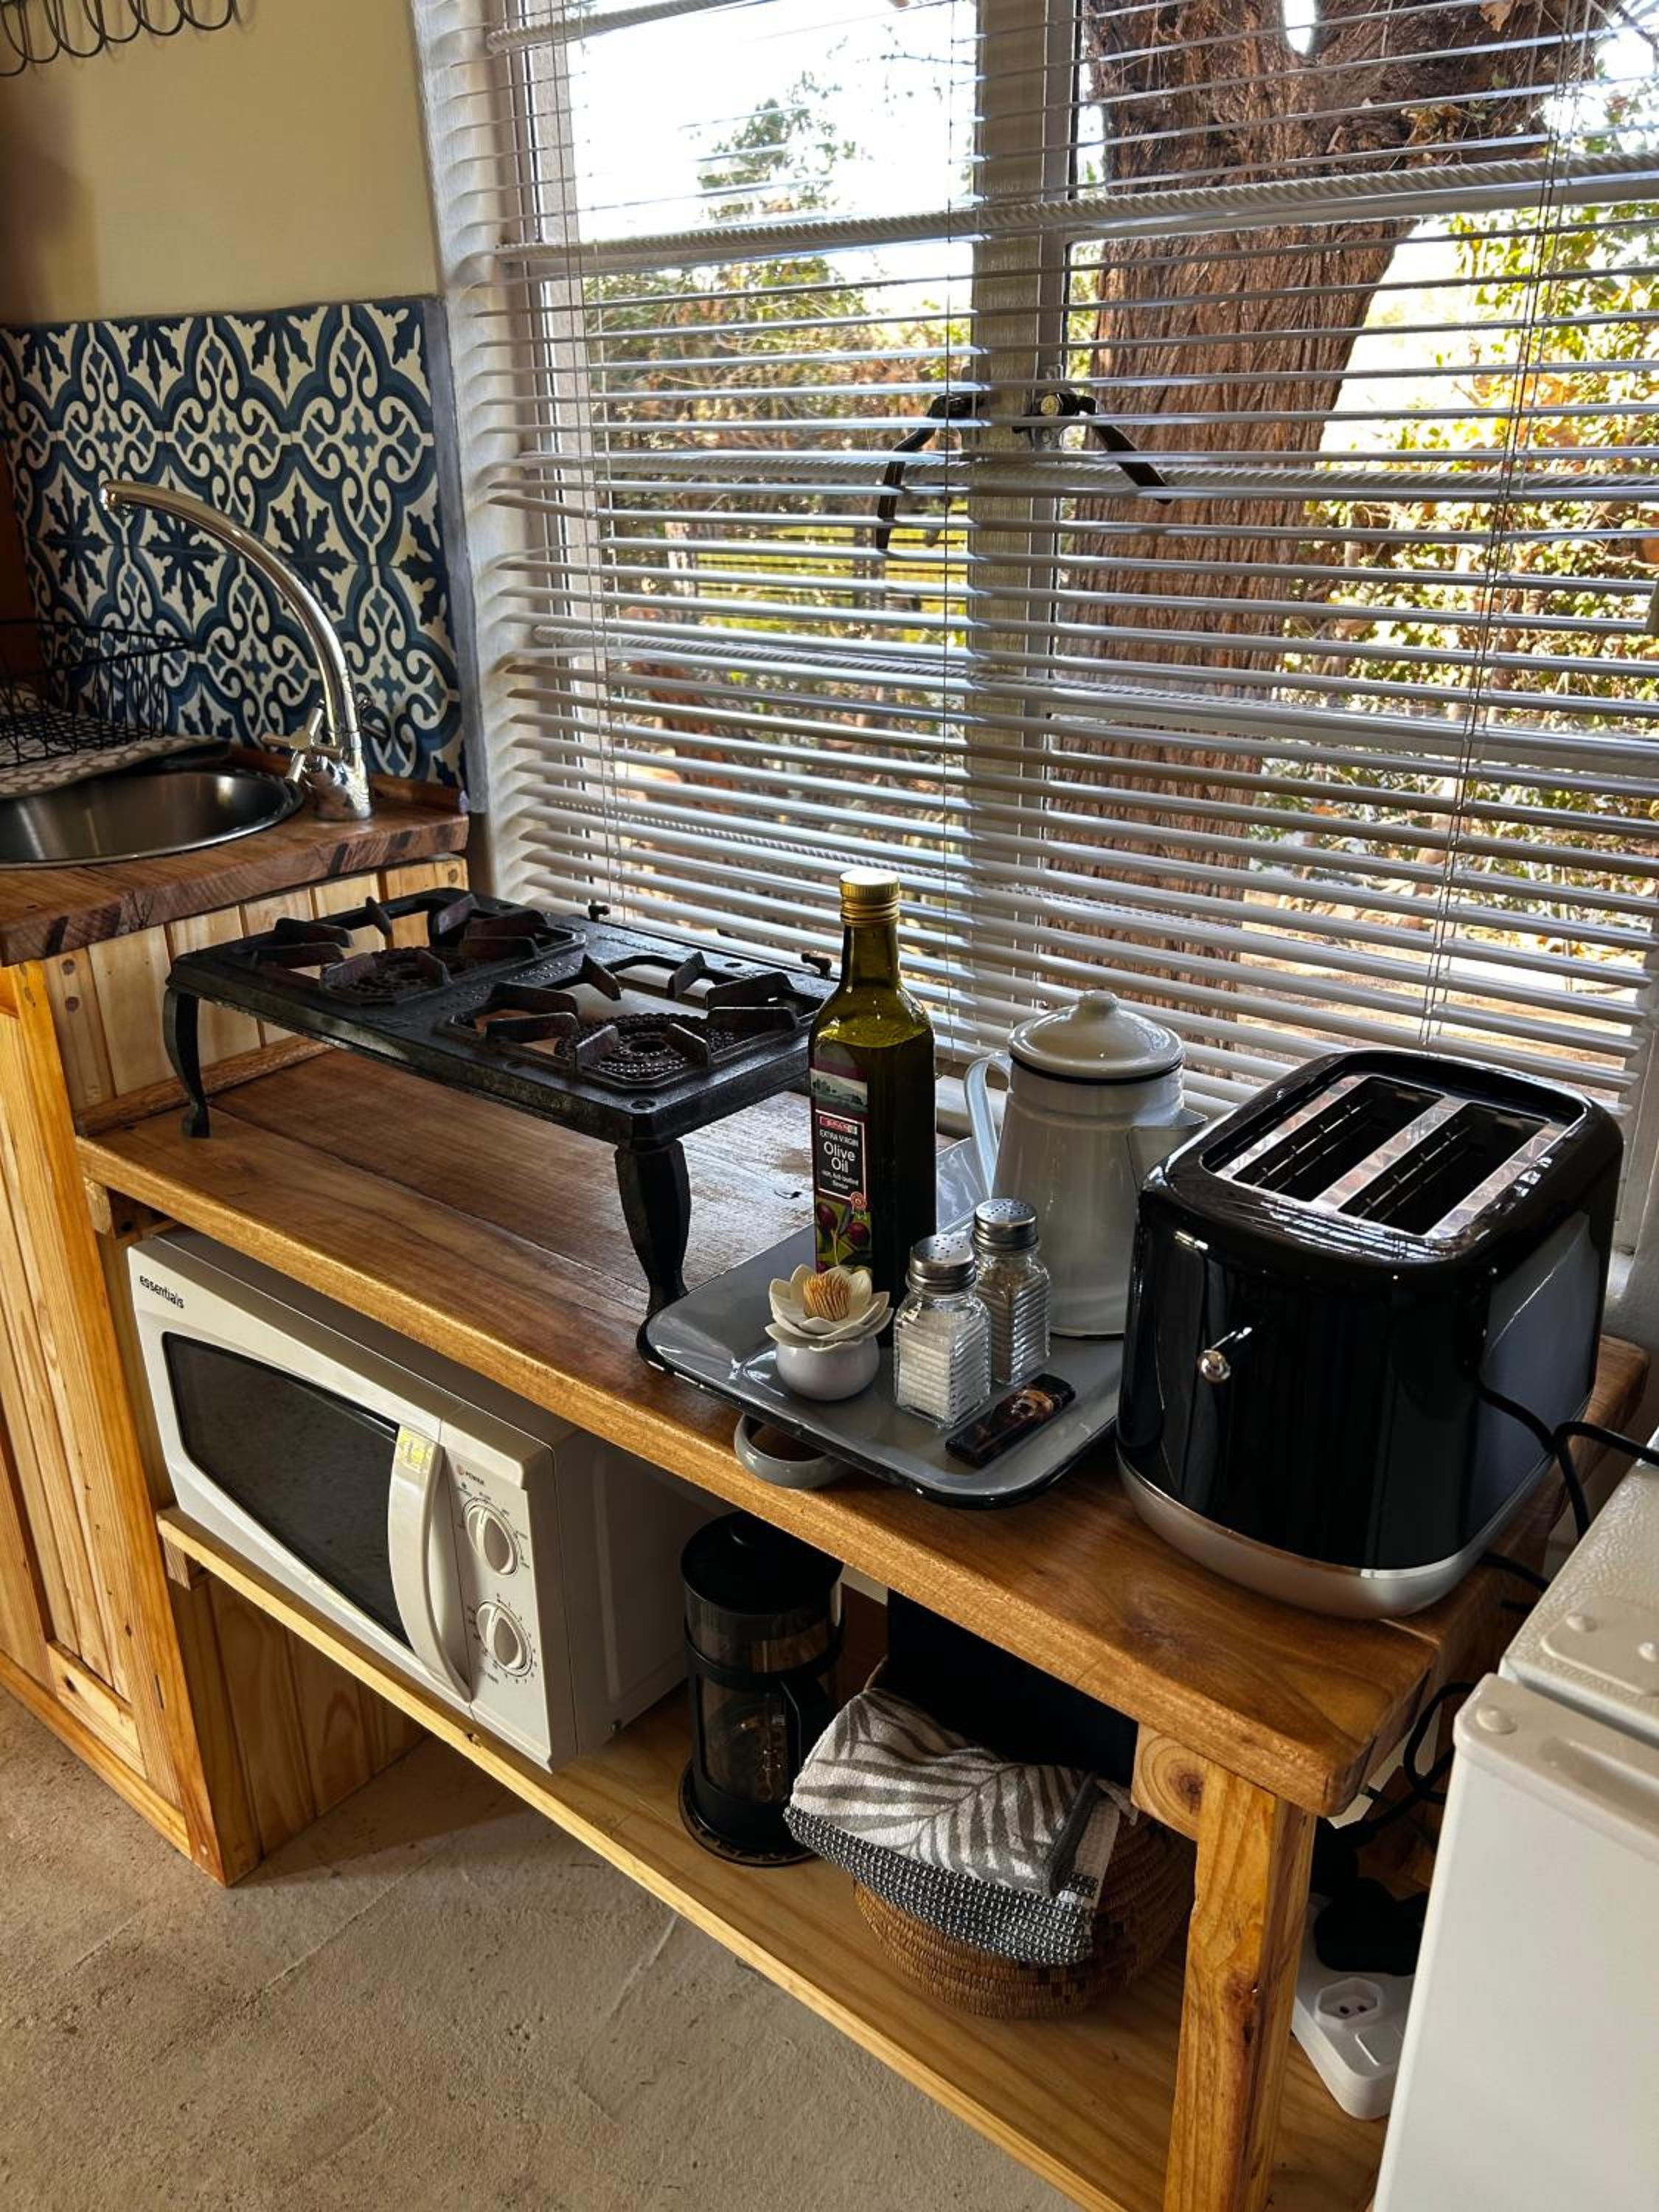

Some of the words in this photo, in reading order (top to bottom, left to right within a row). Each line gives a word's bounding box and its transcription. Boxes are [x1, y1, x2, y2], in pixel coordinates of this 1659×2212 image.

[824, 1141, 855, 1161] Olive
[831, 1157, 849, 1173] Oil
[139, 1275, 184, 1309] essentials
